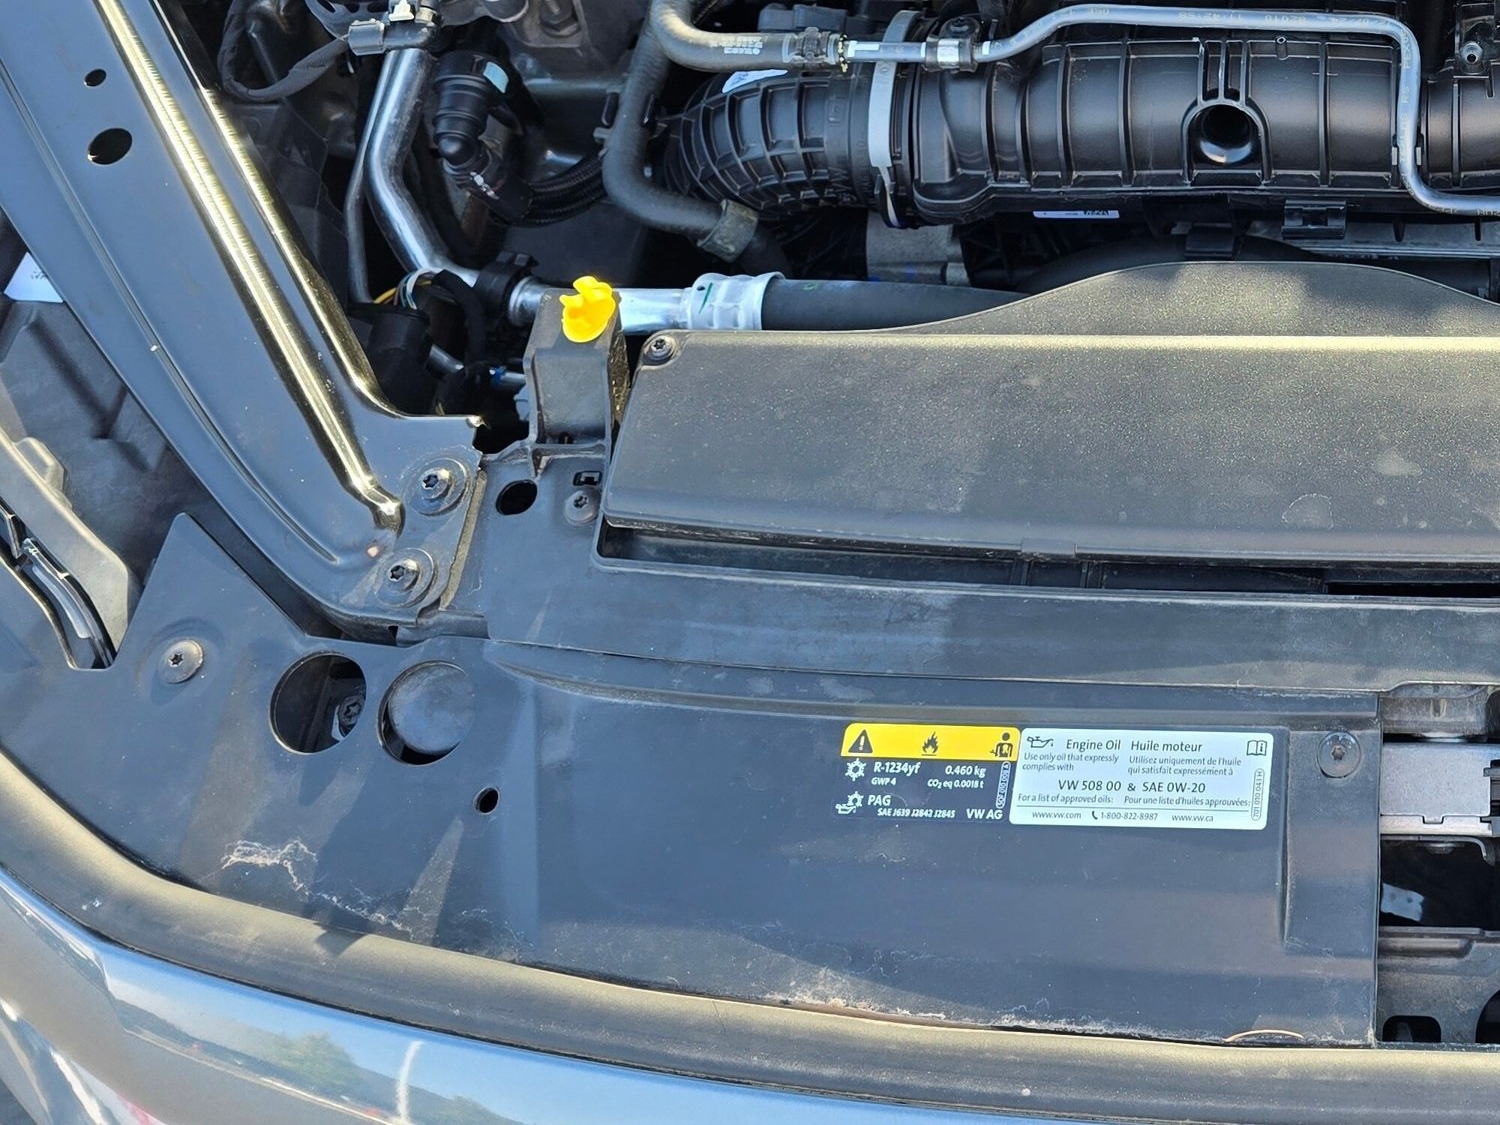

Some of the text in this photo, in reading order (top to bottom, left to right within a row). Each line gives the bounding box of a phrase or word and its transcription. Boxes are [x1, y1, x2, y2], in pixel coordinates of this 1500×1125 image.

[1066, 739, 1121, 752] Engine Oil
[1131, 741, 1202, 752] Huile moteur
[1024, 753, 1038, 761] Use
[1039, 754, 1057, 763] only
[1067, 754, 1083, 762] that
[1084, 755, 1119, 764] expressly
[1129, 756, 1157, 764] Utilisez
[1159, 757, 1205, 767] uniquement
[1207, 758, 1217, 766] de
[874, 762, 986, 778] R-1234yf 0.460 kg
[1022, 763, 1074, 773] complies with
[1128, 766, 1234, 777] qui satisfait expressément à
[871, 777, 897, 786] GWP 4
[943, 780, 984, 790] eq 0.0018 t
[1058, 780, 1206, 793] VW 508 00 & SAE 0W-20
[868, 795, 892, 806] PAG
[1018, 793, 1030, 802] For
[1038, 794, 1050, 802] list
[1052, 794, 1060, 803] of
[1061, 795, 1097, 805] approved
[1098, 796, 1114, 804] oils:
[1124, 796, 1141, 804] Pour
[1159, 796, 1174, 805] liste
[1205, 797, 1250, 808] approuvées:
[877, 808, 892, 817] SAE
[966, 809, 1003, 820] VW AG
[1032, 811, 1214, 822] www.vw.com 1-800-822-8987 www.vw.ca
